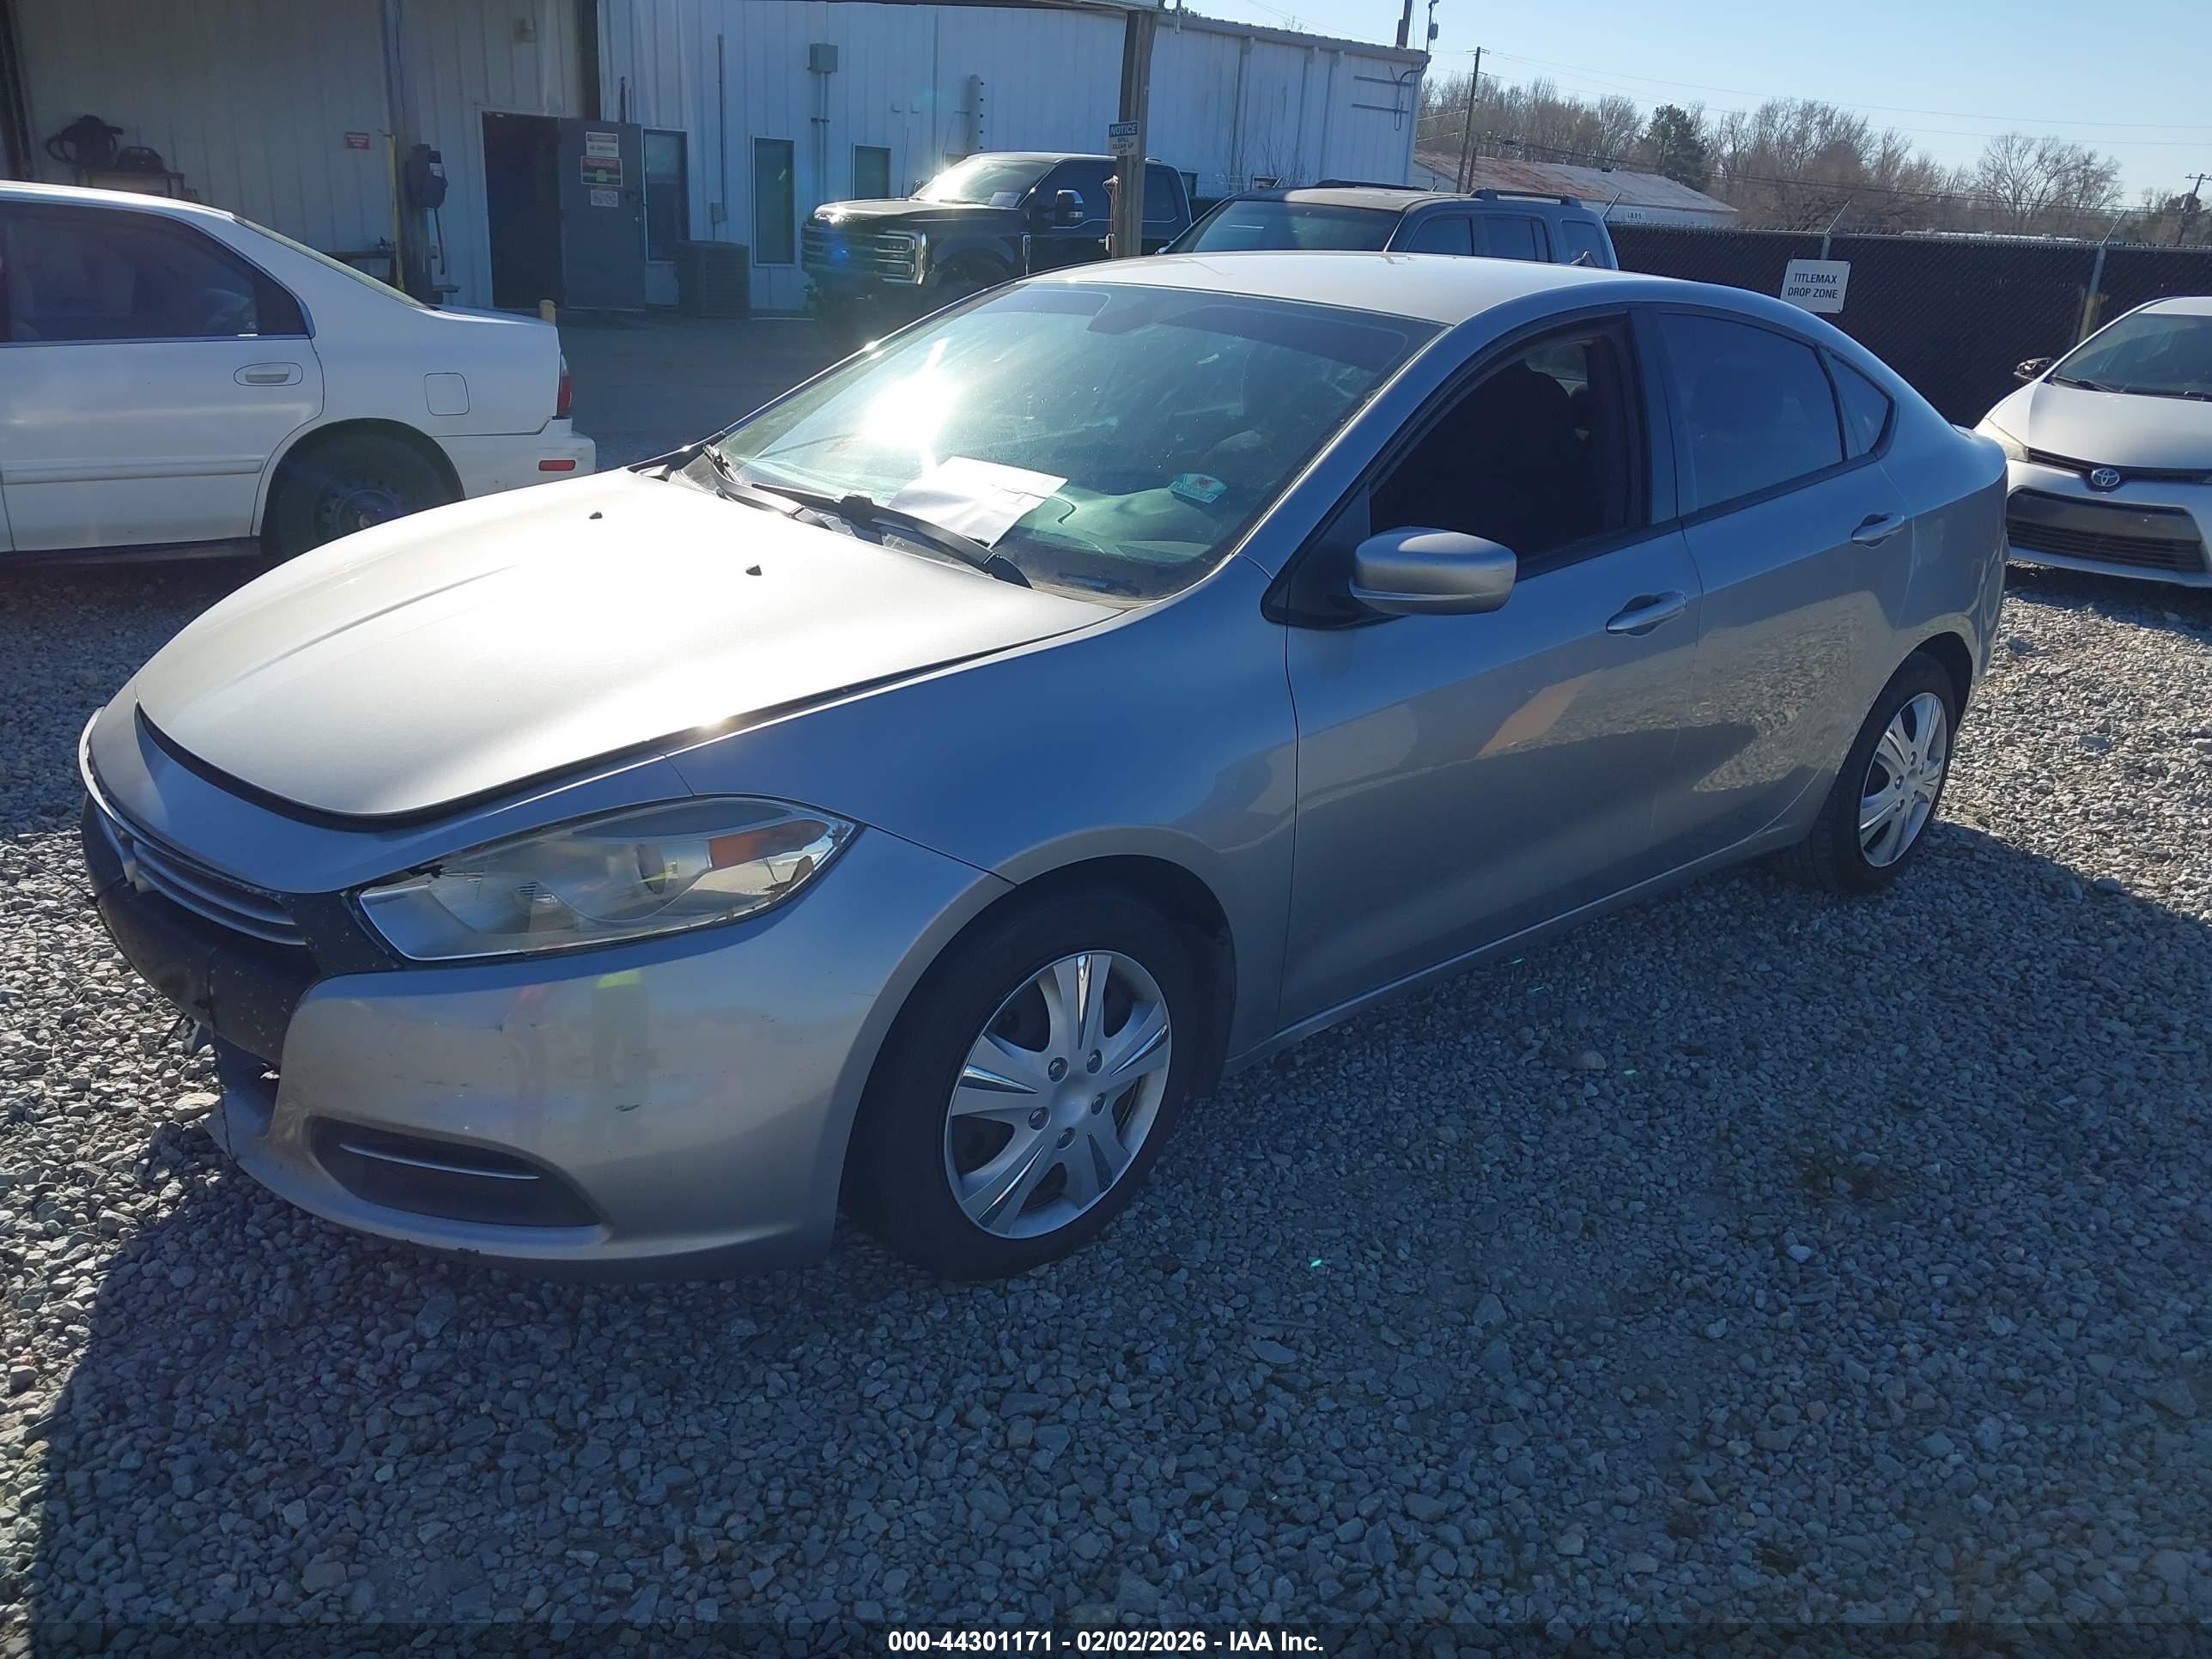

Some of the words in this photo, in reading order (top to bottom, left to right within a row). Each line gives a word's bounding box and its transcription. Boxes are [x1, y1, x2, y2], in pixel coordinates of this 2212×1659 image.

[1110, 124, 1137, 137] NOTICE
[1794, 273, 1838, 284] TITLEMAX
[1788, 287, 1811, 297] DROP
[1813, 289, 1838, 299] ZONE
